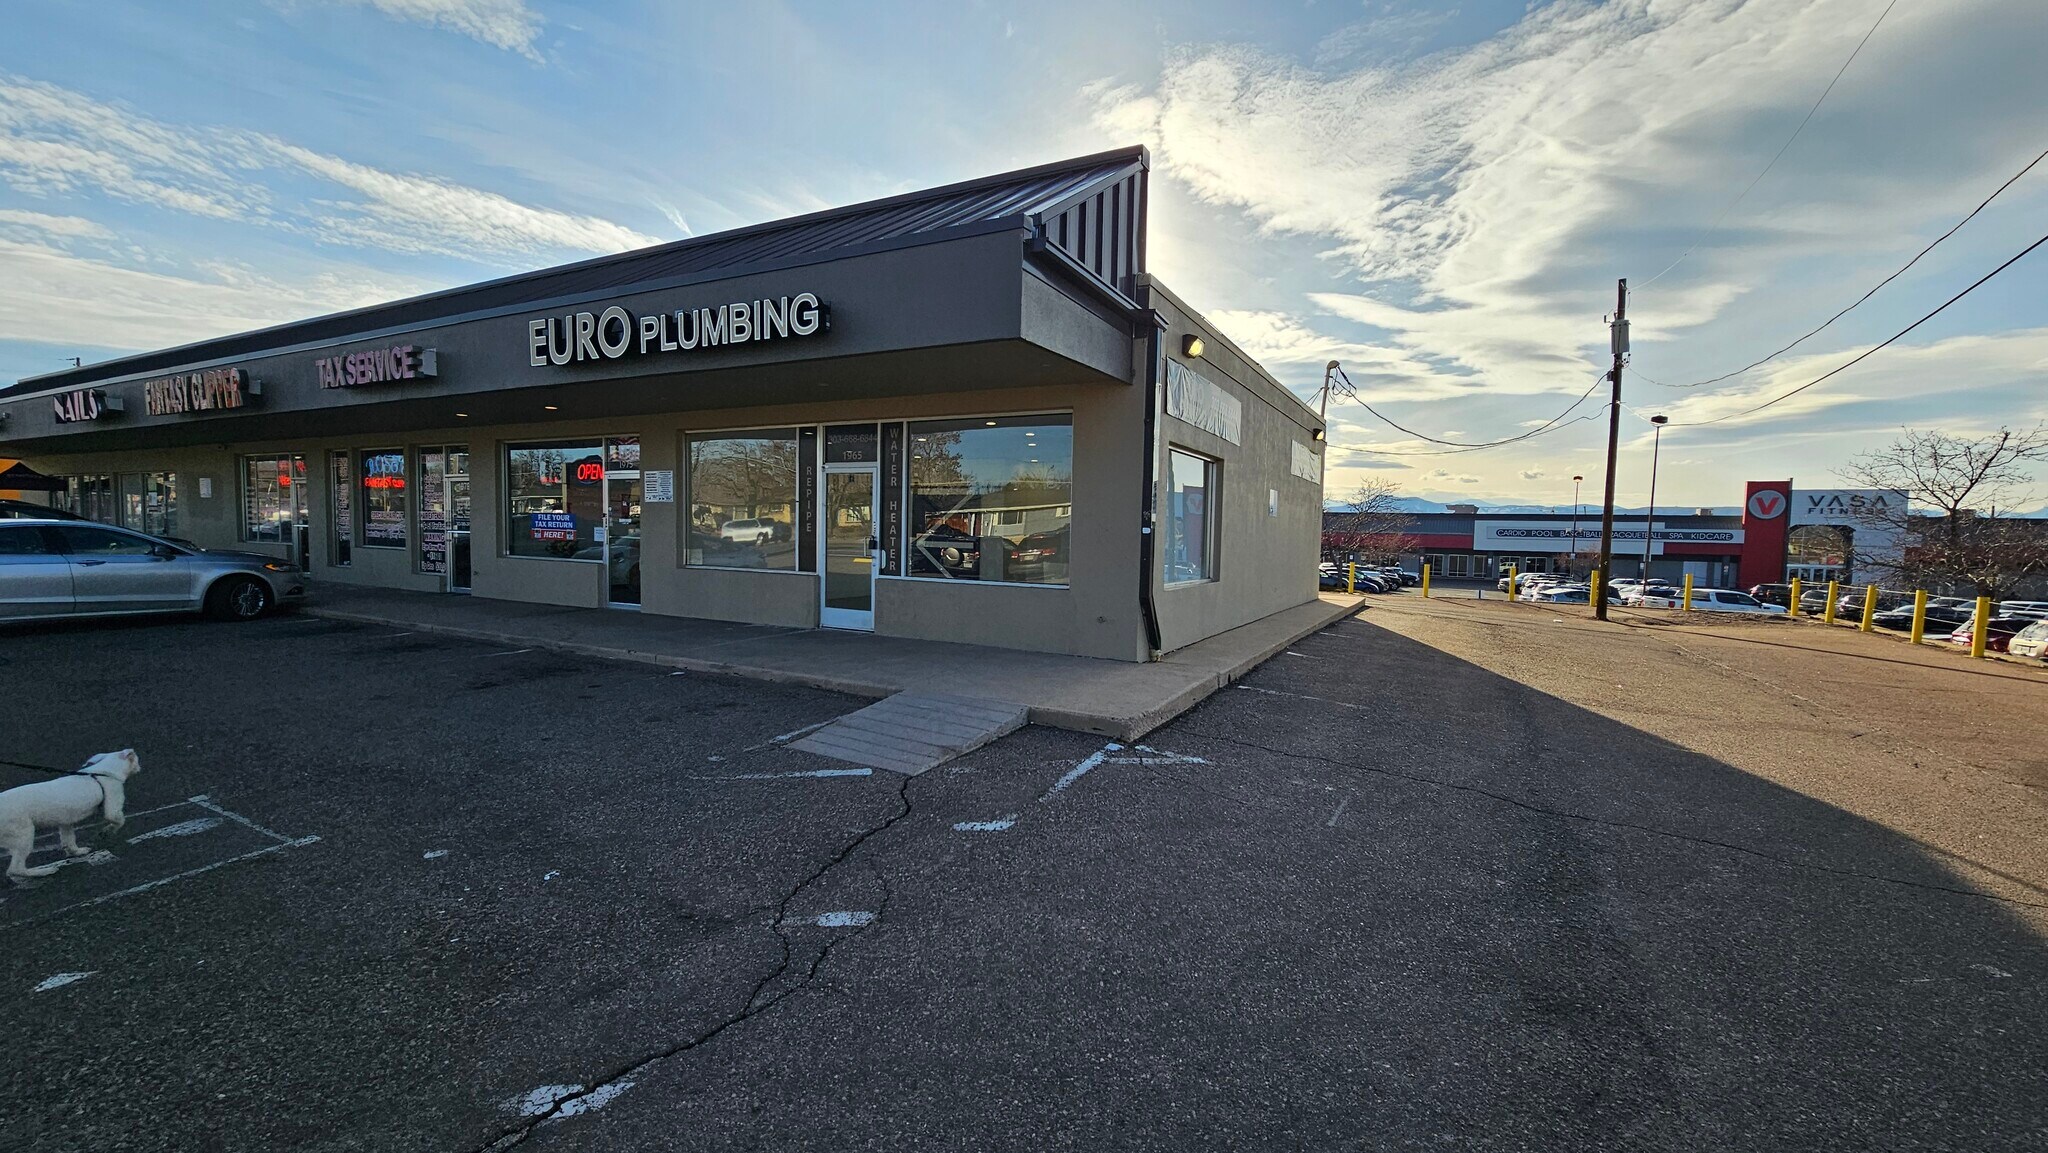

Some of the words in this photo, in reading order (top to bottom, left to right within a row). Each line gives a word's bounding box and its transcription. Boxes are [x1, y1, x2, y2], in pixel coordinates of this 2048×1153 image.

[528, 305, 631, 367] EURO
[640, 292, 819, 354] PLUMBING
[315, 356, 346, 389] TAX
[345, 344, 415, 385] SERVICE
[145, 375, 190, 415] FANTASY
[191, 367, 243, 411] CLIPPER
[53, 388, 98, 421] NAILS
[842, 450, 863, 461] 1965
[889, 428, 900, 487] WATER
[577, 463, 604, 480] OPEN
[1755, 497, 1780, 515] V
[1807, 494, 1889, 508] VASA
[1807, 507, 1887, 515] FITNSS
[543, 531, 564, 539] HERE!
[889, 503, 898, 571] HEATER
